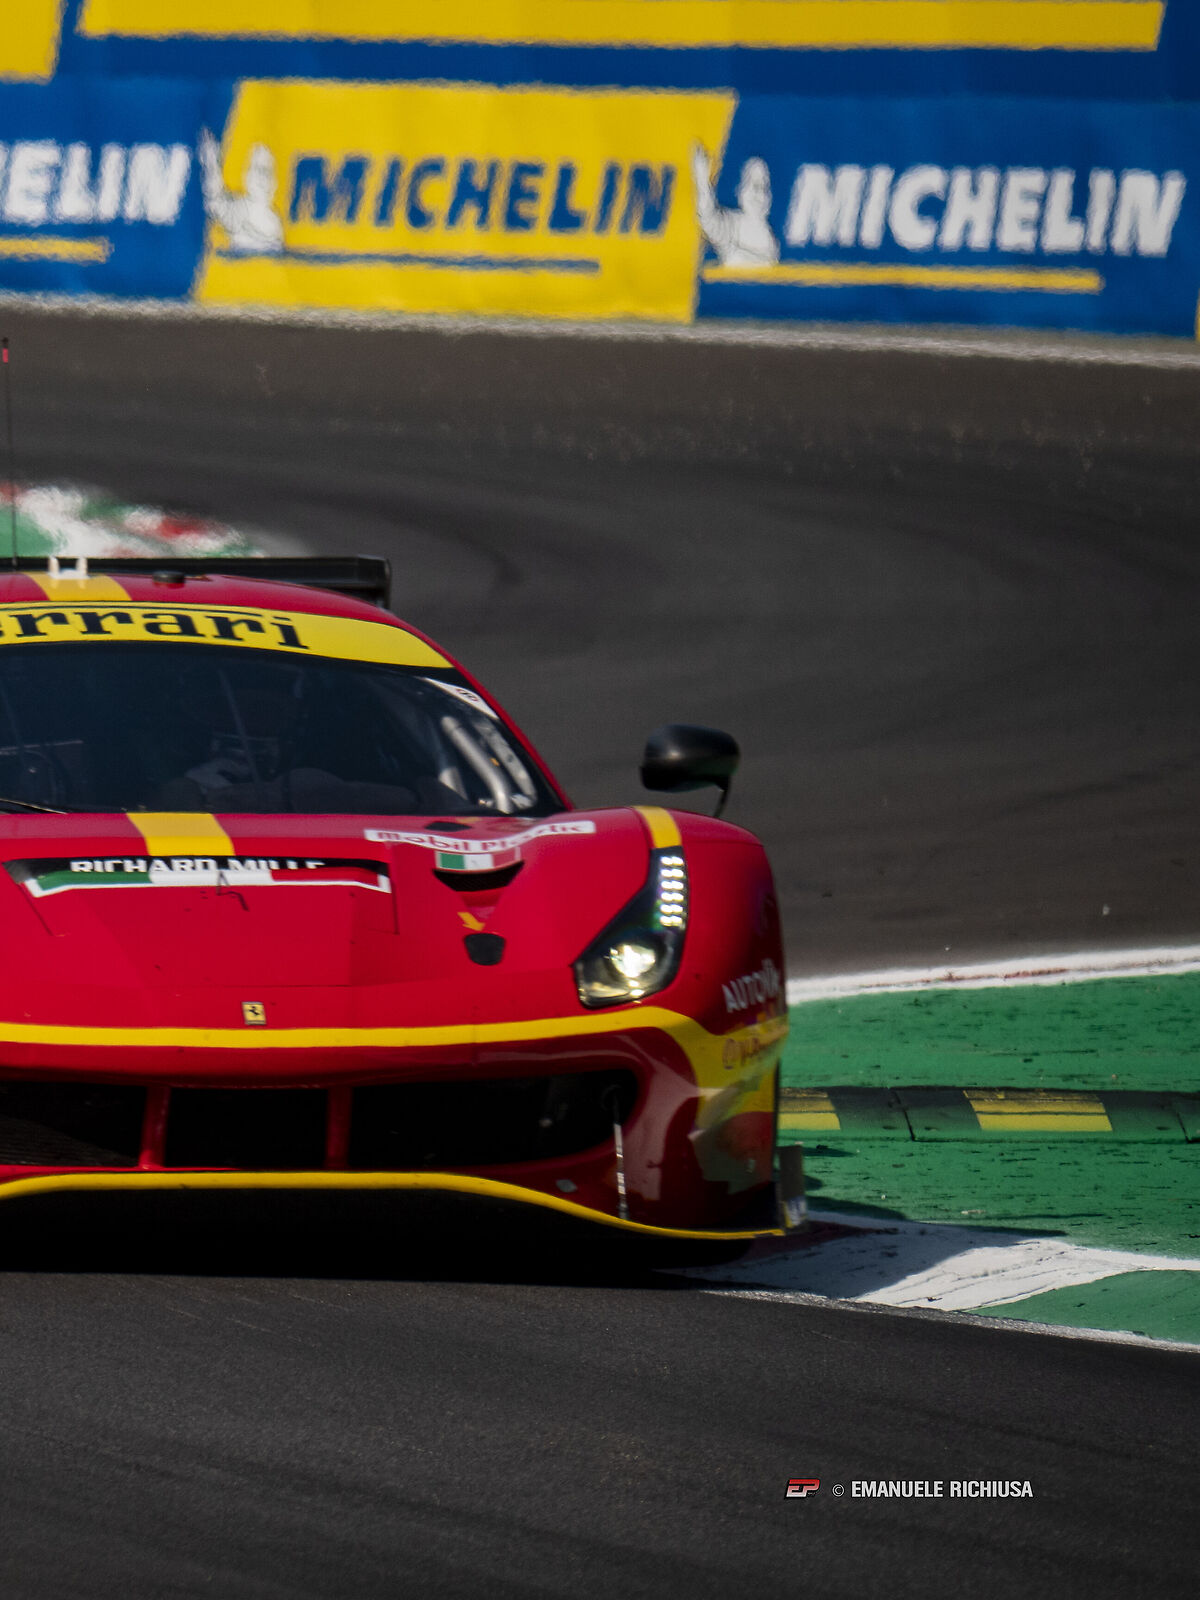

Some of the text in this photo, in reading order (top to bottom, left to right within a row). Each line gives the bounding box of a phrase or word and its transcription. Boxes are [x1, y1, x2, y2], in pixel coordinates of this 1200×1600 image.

[290, 153, 675, 239] MICHELIN
[784, 164, 1186, 257] MICHELIN
[377, 832, 472, 851] mobil
